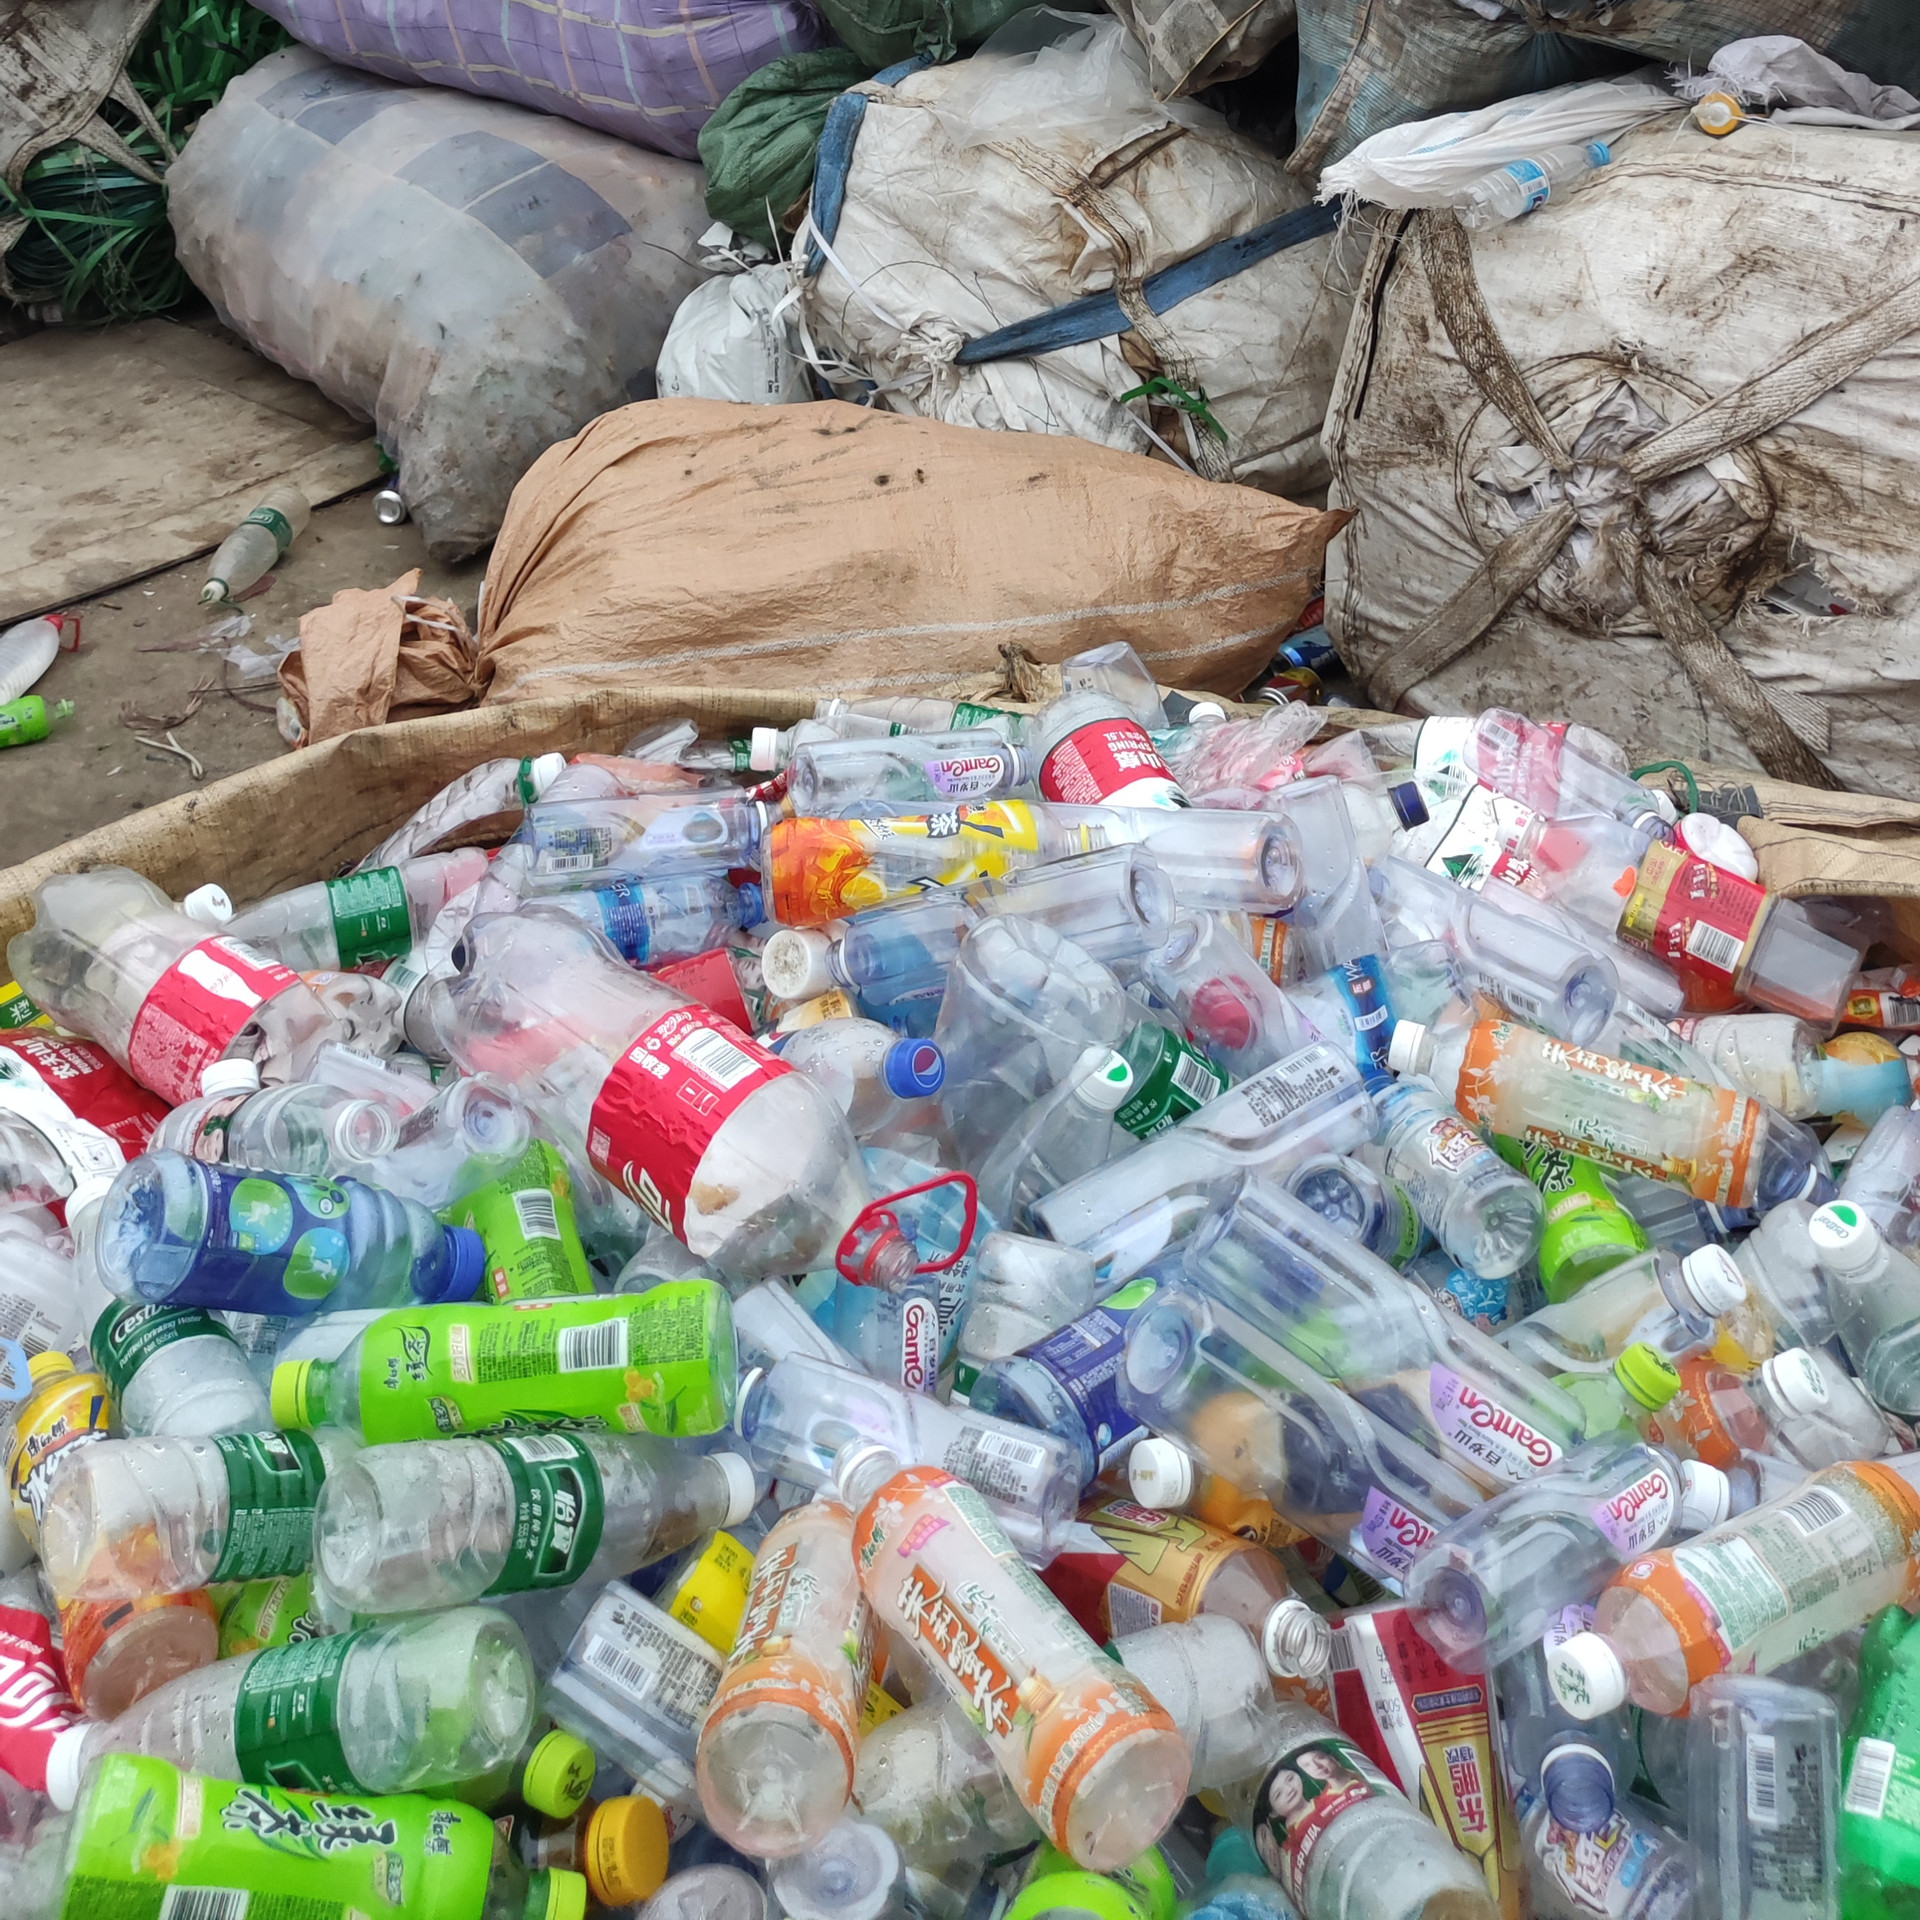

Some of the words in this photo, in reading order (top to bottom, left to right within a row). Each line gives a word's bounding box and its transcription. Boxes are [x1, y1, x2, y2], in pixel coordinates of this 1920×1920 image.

[940, 753, 1001, 779] Ganten
[947, 780, 979, 793] 百岁山
[1541, 1040, 1688, 1101] 茉莉蜜茶
[1539, 1147, 1577, 1196] 茶
[903, 1304, 925, 1389] Gante
[1453, 1428, 1502, 1467] 百岁山
[1457, 1385, 1552, 1467] Ganten
[523, 1487, 545, 1560] 饮用纯净水
[1607, 1474, 1669, 1521] Ganten
[1627, 1521, 1657, 1550] 百岁山
[896, 1571, 1012, 1735] 茉莉蜜茶
[1443, 1745, 1474, 1763] 特饮
[224, 1785, 397, 1855] 绿茶
[1450, 1763, 1487, 1832] 东鹏
